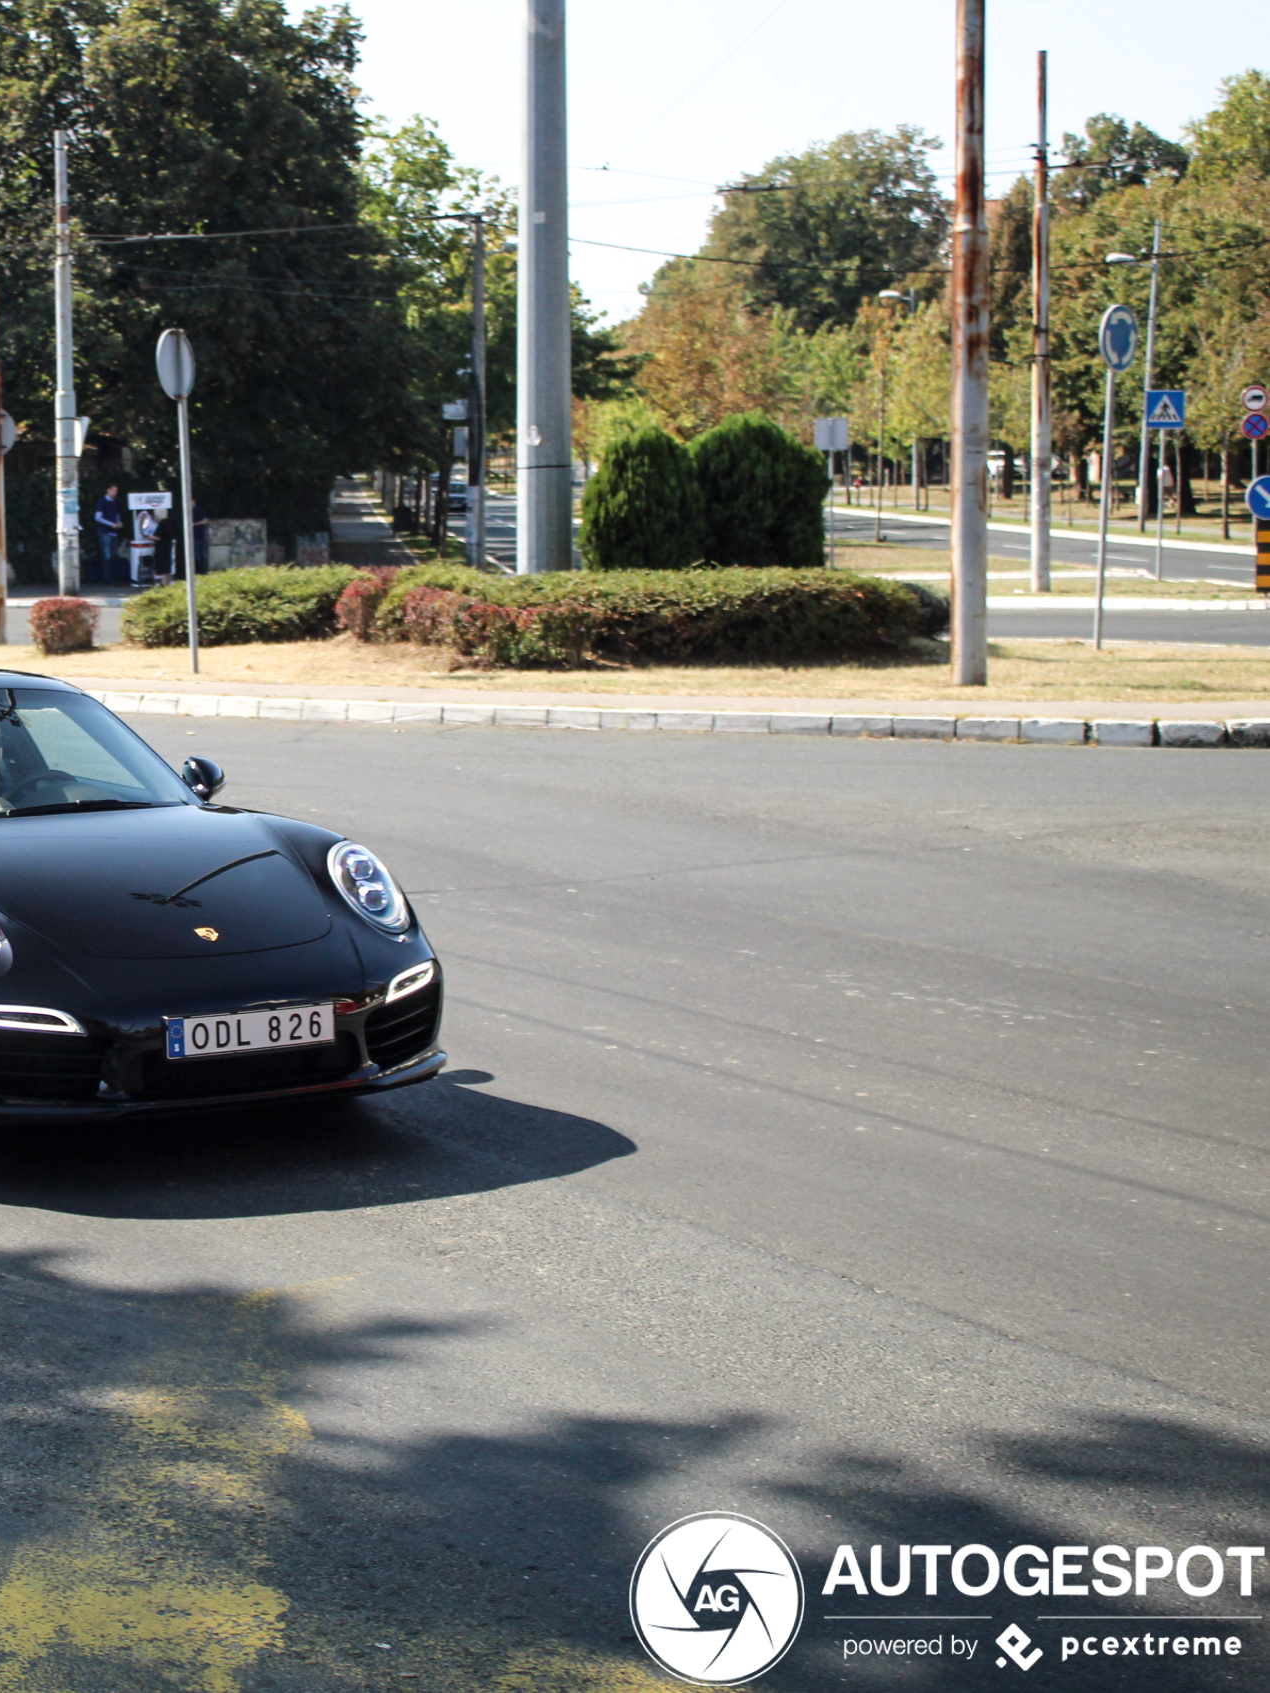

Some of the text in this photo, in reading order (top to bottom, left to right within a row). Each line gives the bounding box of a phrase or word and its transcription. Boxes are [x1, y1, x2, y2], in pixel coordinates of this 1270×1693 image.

[192, 1011, 322, 1049] ODL 826
[174, 1043, 180, 1053] S
